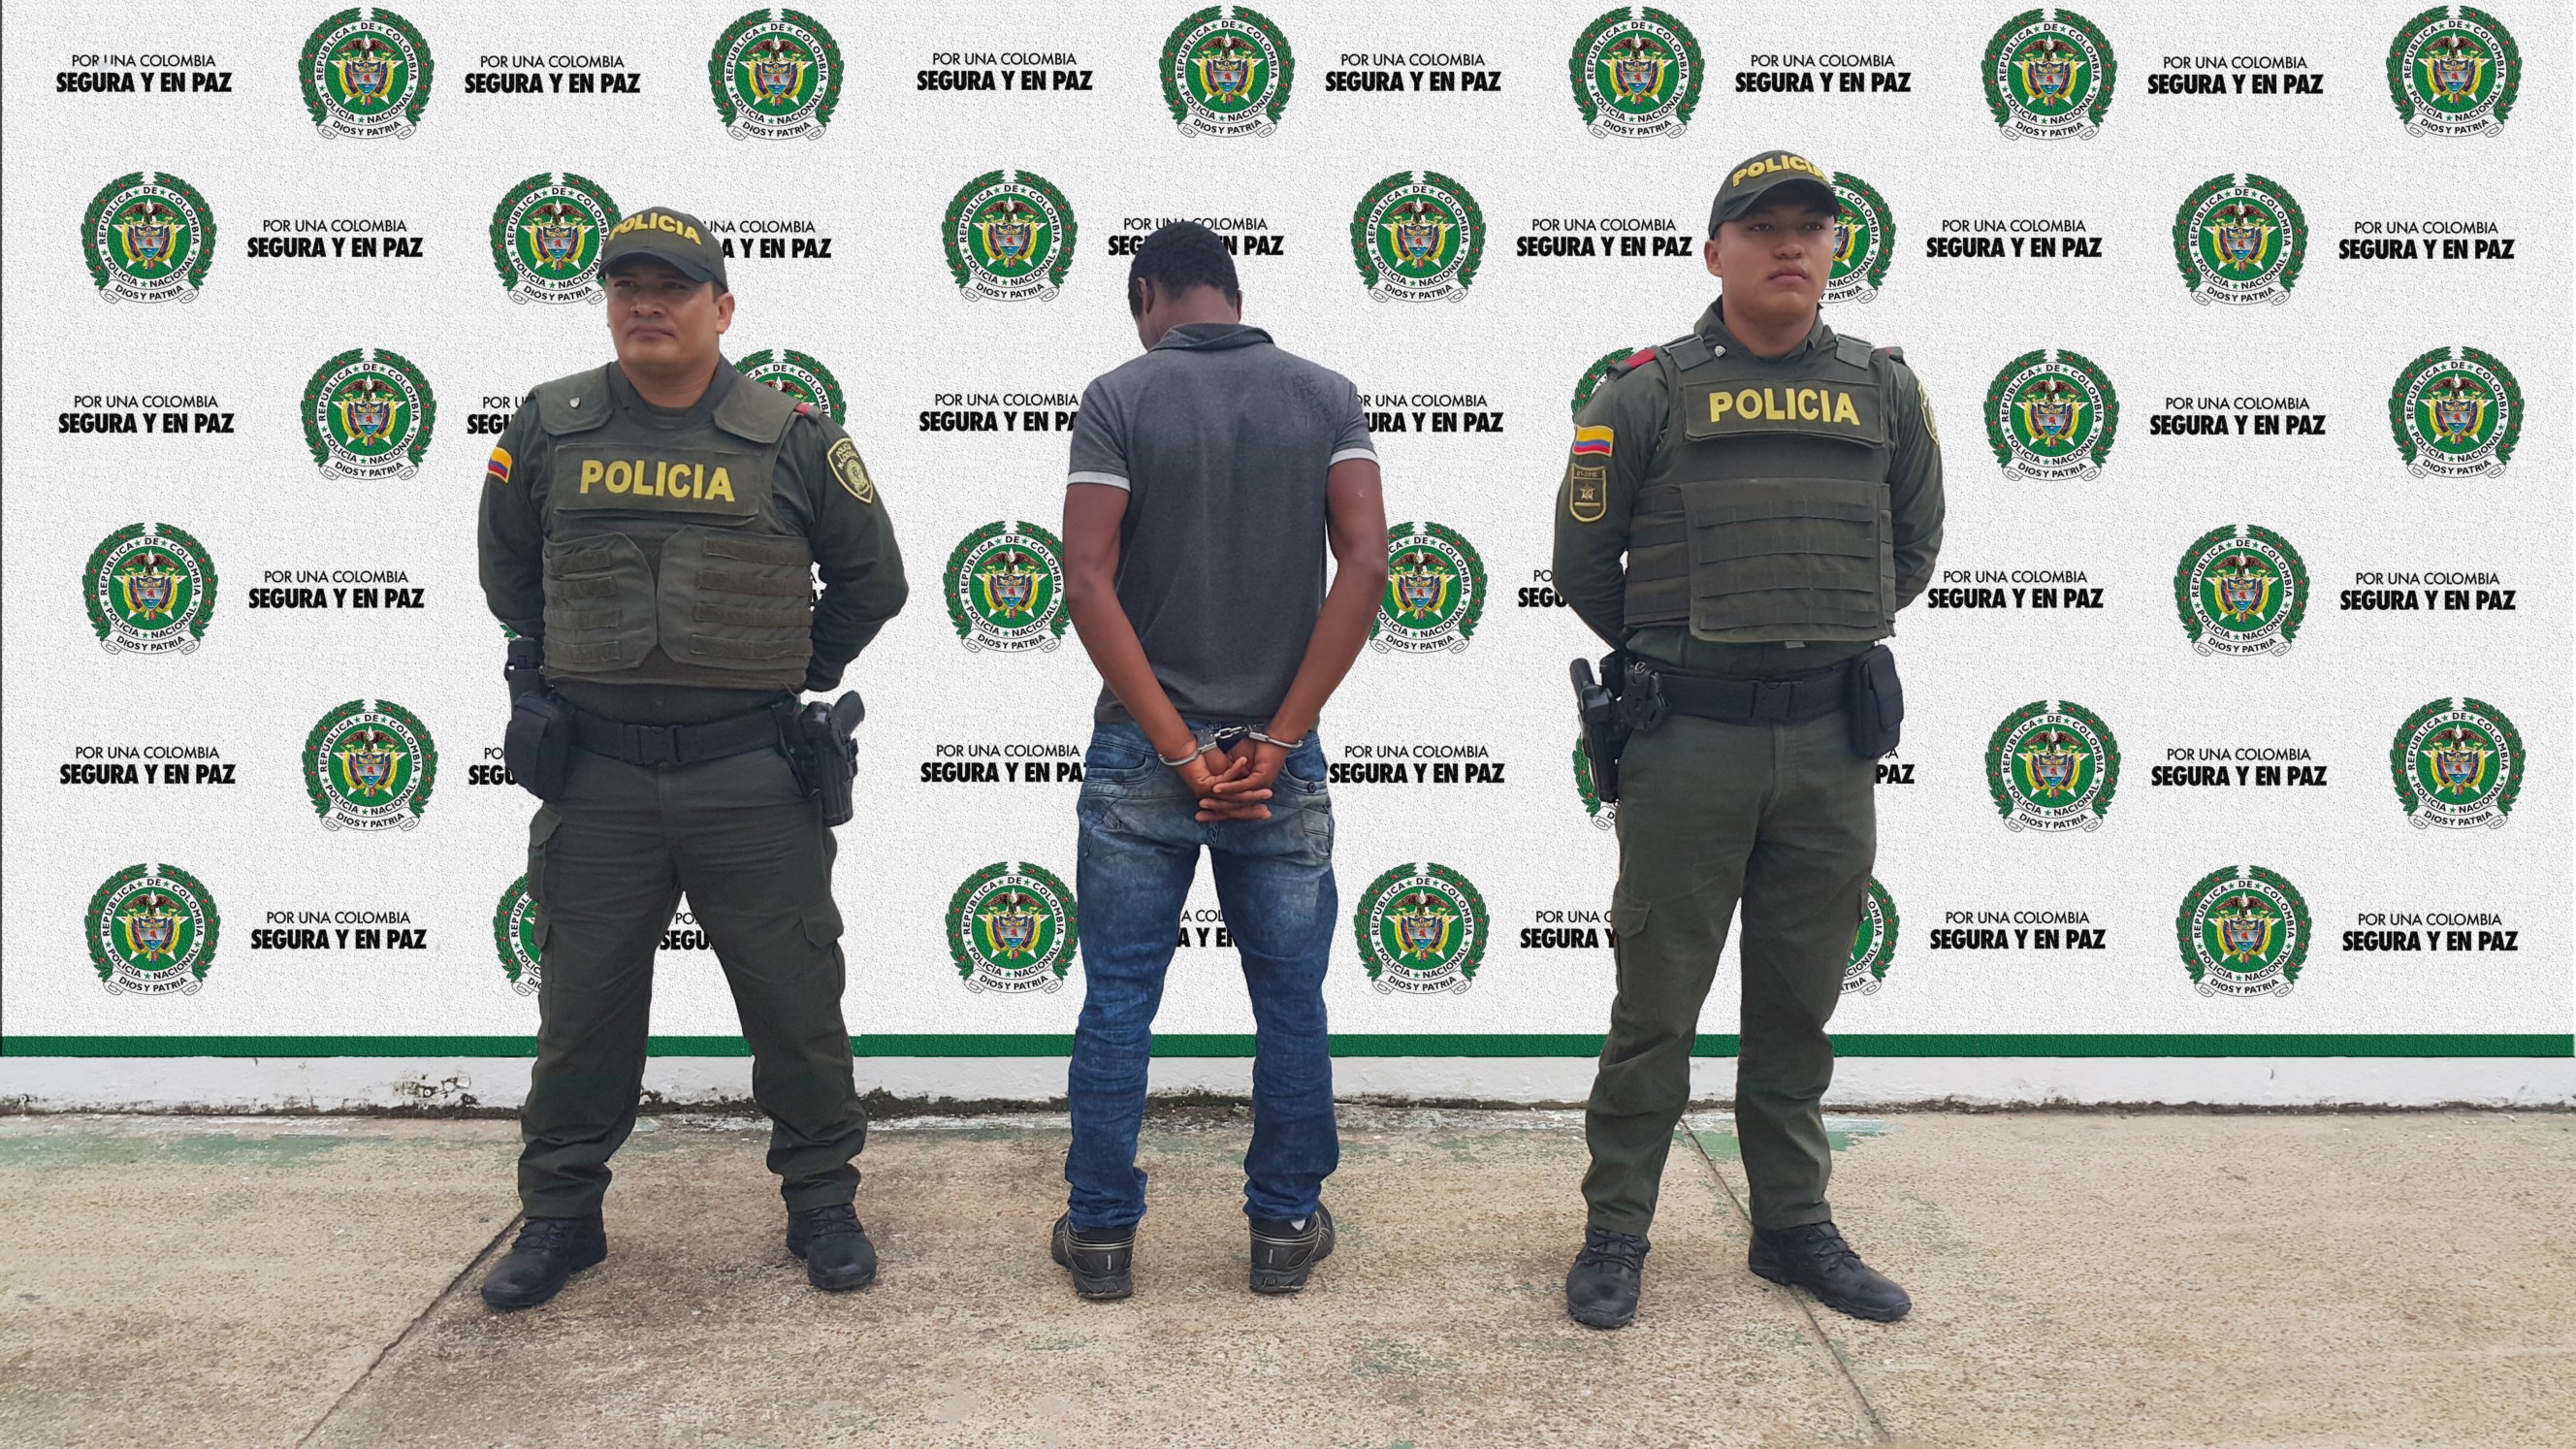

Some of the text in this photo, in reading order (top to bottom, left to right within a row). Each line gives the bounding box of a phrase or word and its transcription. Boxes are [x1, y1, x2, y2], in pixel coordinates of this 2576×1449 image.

[480, 55, 625, 69] POR UNA COLOMBIA
[932, 52, 1077, 66] POR UNA COLOMBIA
[1246, 27, 1277, 79] COLOMBIA
[1751, 54, 1895, 68] POR UNA COLOMBIA
[2163, 56, 2307, 70] POR UNA COLOMBIA
[465, 73, 641, 94] SEGURA Y EN PAZ
[917, 70, 1093, 91] SEGURA Y EN PAZ
[1735, 72, 1912, 93] SEGURA Y EN PAZ
[2147, 74, 2324, 95] SEGURA Y EN PAZ
[1228, 90, 1273, 121] NACIONAL
[1193, 118, 1261, 134] DIOS Y PATRIA
[1732, 154, 1828, 187] POLICIA
[169, 193, 200, 244] COLOMBIA
[263, 219, 407, 233] POR UNA COLOMBIA
[608, 212, 702, 246] POLICIA
[739, 220, 816, 234] COLOMBIA
[1532, 218, 1677, 232] POR UNA COLOMBIA
[2354, 221, 2498, 235] POR UNA COLOMBIA
[247, 237, 424, 258] SEGURA Y EN PAZ
[739, 238, 832, 259] Y EN PAZ
[1517, 236, 1693, 257] SEGURA Y EN PAZ
[2338, 239, 2515, 260] SEGURA Y EN PAZ
[150, 256, 196, 287] NACIONAL
[115, 284, 183, 300] DIOS Y PATRIA
[74, 395, 218, 408] POR UNA COLOMBIA
[2166, 397, 2310, 410] POR UNA COLOMBIA
[2476, 368, 2507, 419] COLOMBIA
[1709, 387, 1861, 426] POLICIA
[58, 412, 235, 434] SEGURA Y EN PAZ
[2150, 414, 2327, 435] SEGURA Y EN PAZ
[2458, 431, 2503, 462] NACIONAL
[2423, 459, 2491, 474] DIOS Y PATRIA
[579, 459, 736, 502] POLICIA
[264, 570, 408, 584] POR UNA COLOMBIA
[2356, 572, 2500, 586] POR UNA COLOMBIA
[248, 588, 425, 609] SEGURA Y EN PAZ
[2340, 590, 2517, 611] SEGURA Y EN PAZ
[390, 721, 421, 772] COLOMBIA
[1344, 745, 1489, 758] POR UNA COLOMBIA
[1329, 762, 1505, 784] SEGURA Y EN PAZ
[1875, 763, 1915, 785] PAZ
[371, 784, 417, 815] NACIONAL
[337, 812, 404, 827] DIOS Y PATRIA
[267, 911, 411, 924] POR UNA COLOMBIA
[1441, 885, 1472, 936] COLOMBIA
[1946, 911, 2090, 924] POR UNA COLOMBIA
[251, 928, 428, 950] SEGURA Y EN PAZ
[1930, 928, 2107, 950] SEGURA Y EN PAZ
[1423, 948, 1468, 979] NACIONAL
[1388, 976, 1456, 991] DIOS Y PATRIA
